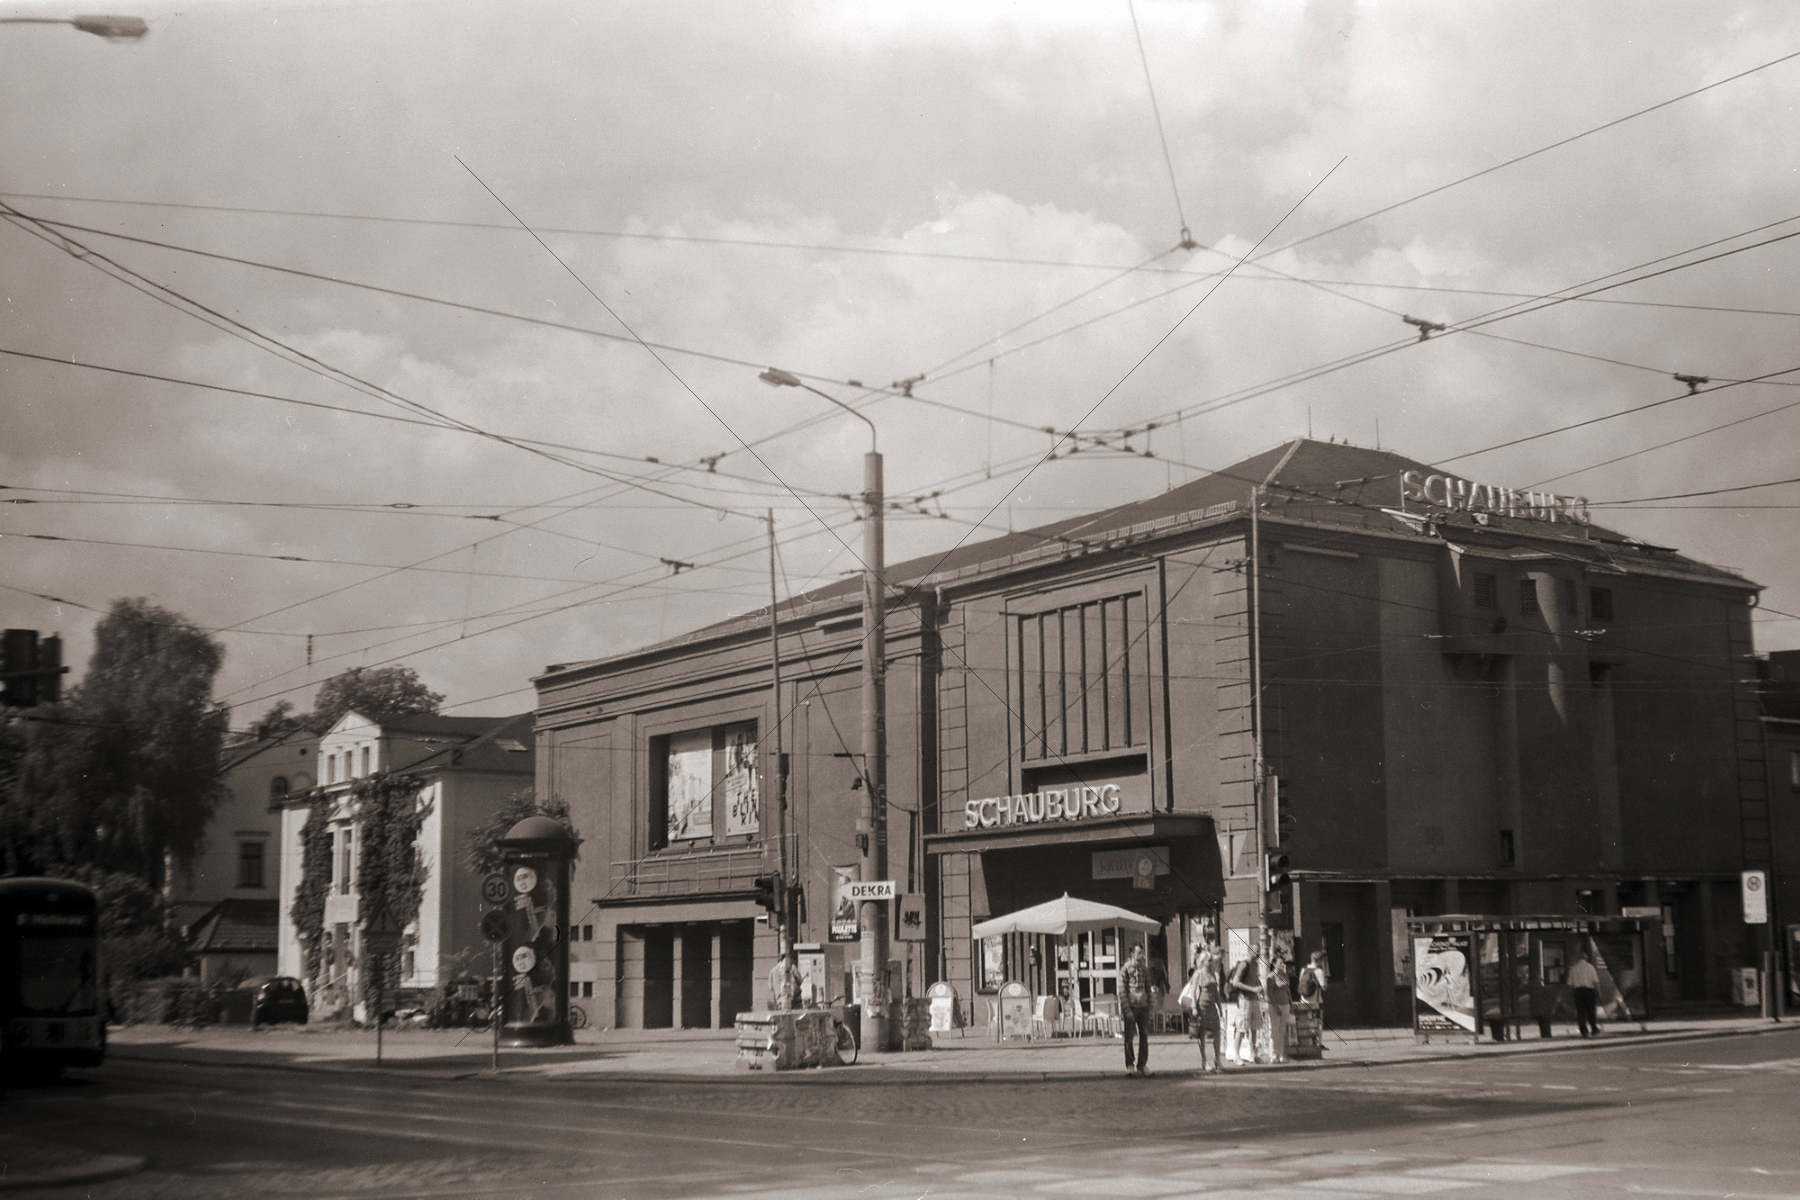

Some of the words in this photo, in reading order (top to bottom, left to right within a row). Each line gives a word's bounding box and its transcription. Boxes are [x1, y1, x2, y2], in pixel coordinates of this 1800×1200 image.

[1403, 470, 1592, 525] SCHAUBURG
[737, 789, 756, 806] THE
[965, 784, 1121, 828] SCHAUBURG
[732, 798, 758, 818] BLIN
[741, 810, 760, 827] RIN
[487, 882, 507, 898] 30
[852, 885, 892, 897] DEKRA
